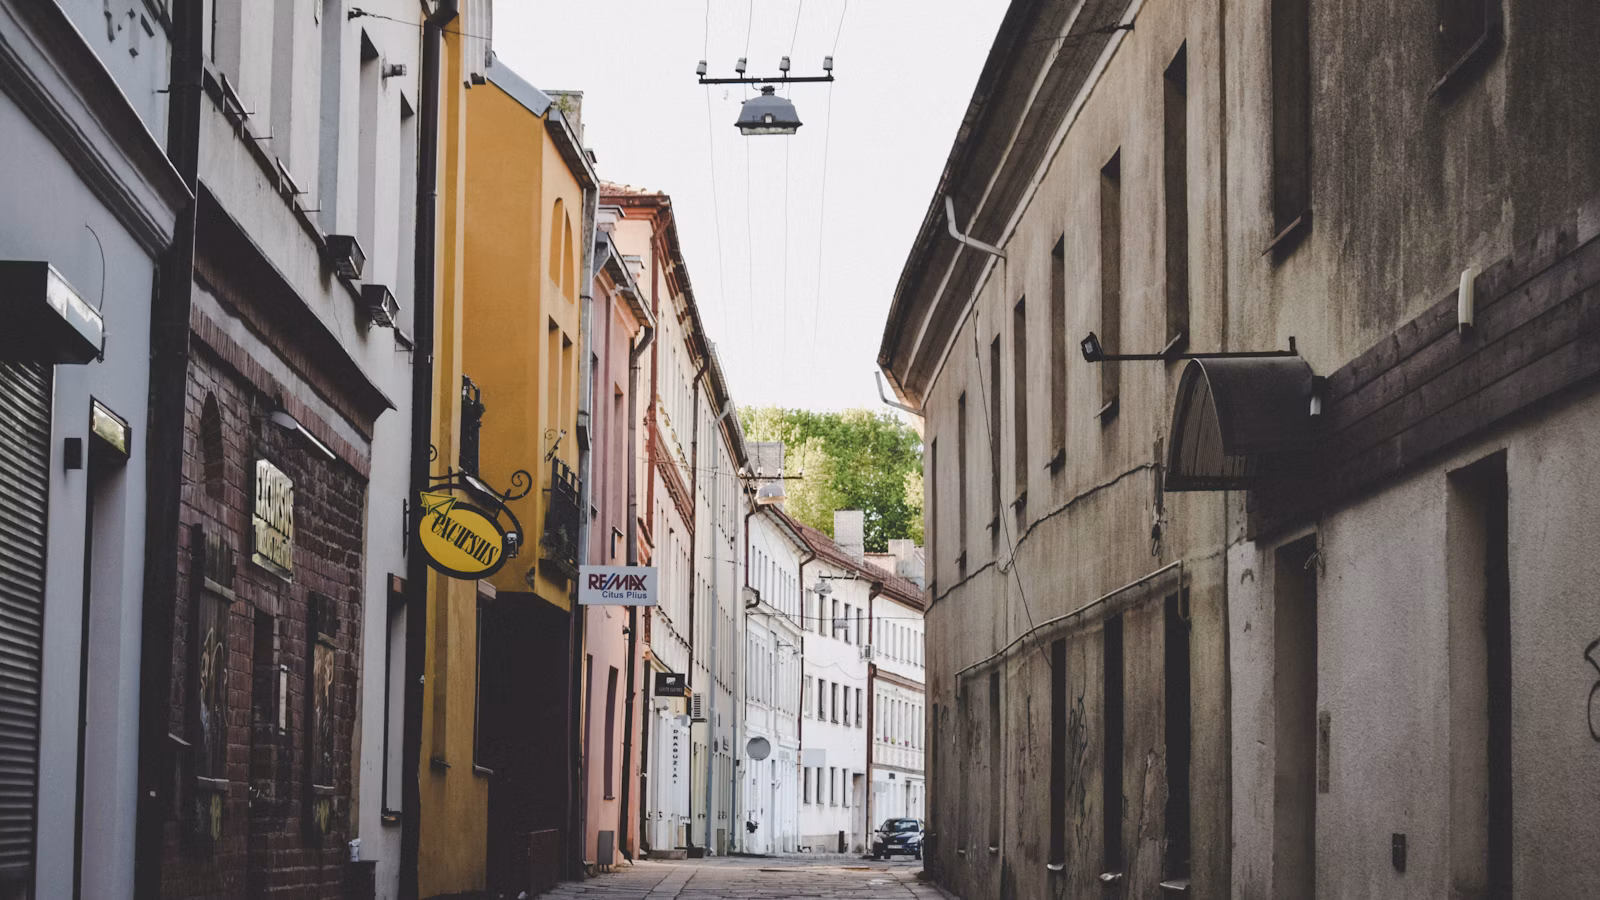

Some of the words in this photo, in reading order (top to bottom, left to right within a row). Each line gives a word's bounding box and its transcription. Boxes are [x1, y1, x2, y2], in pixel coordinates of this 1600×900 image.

[588, 573, 648, 591] RE/MAX
[602, 590, 624, 599] Citus
[626, 591, 648, 600] Plius
